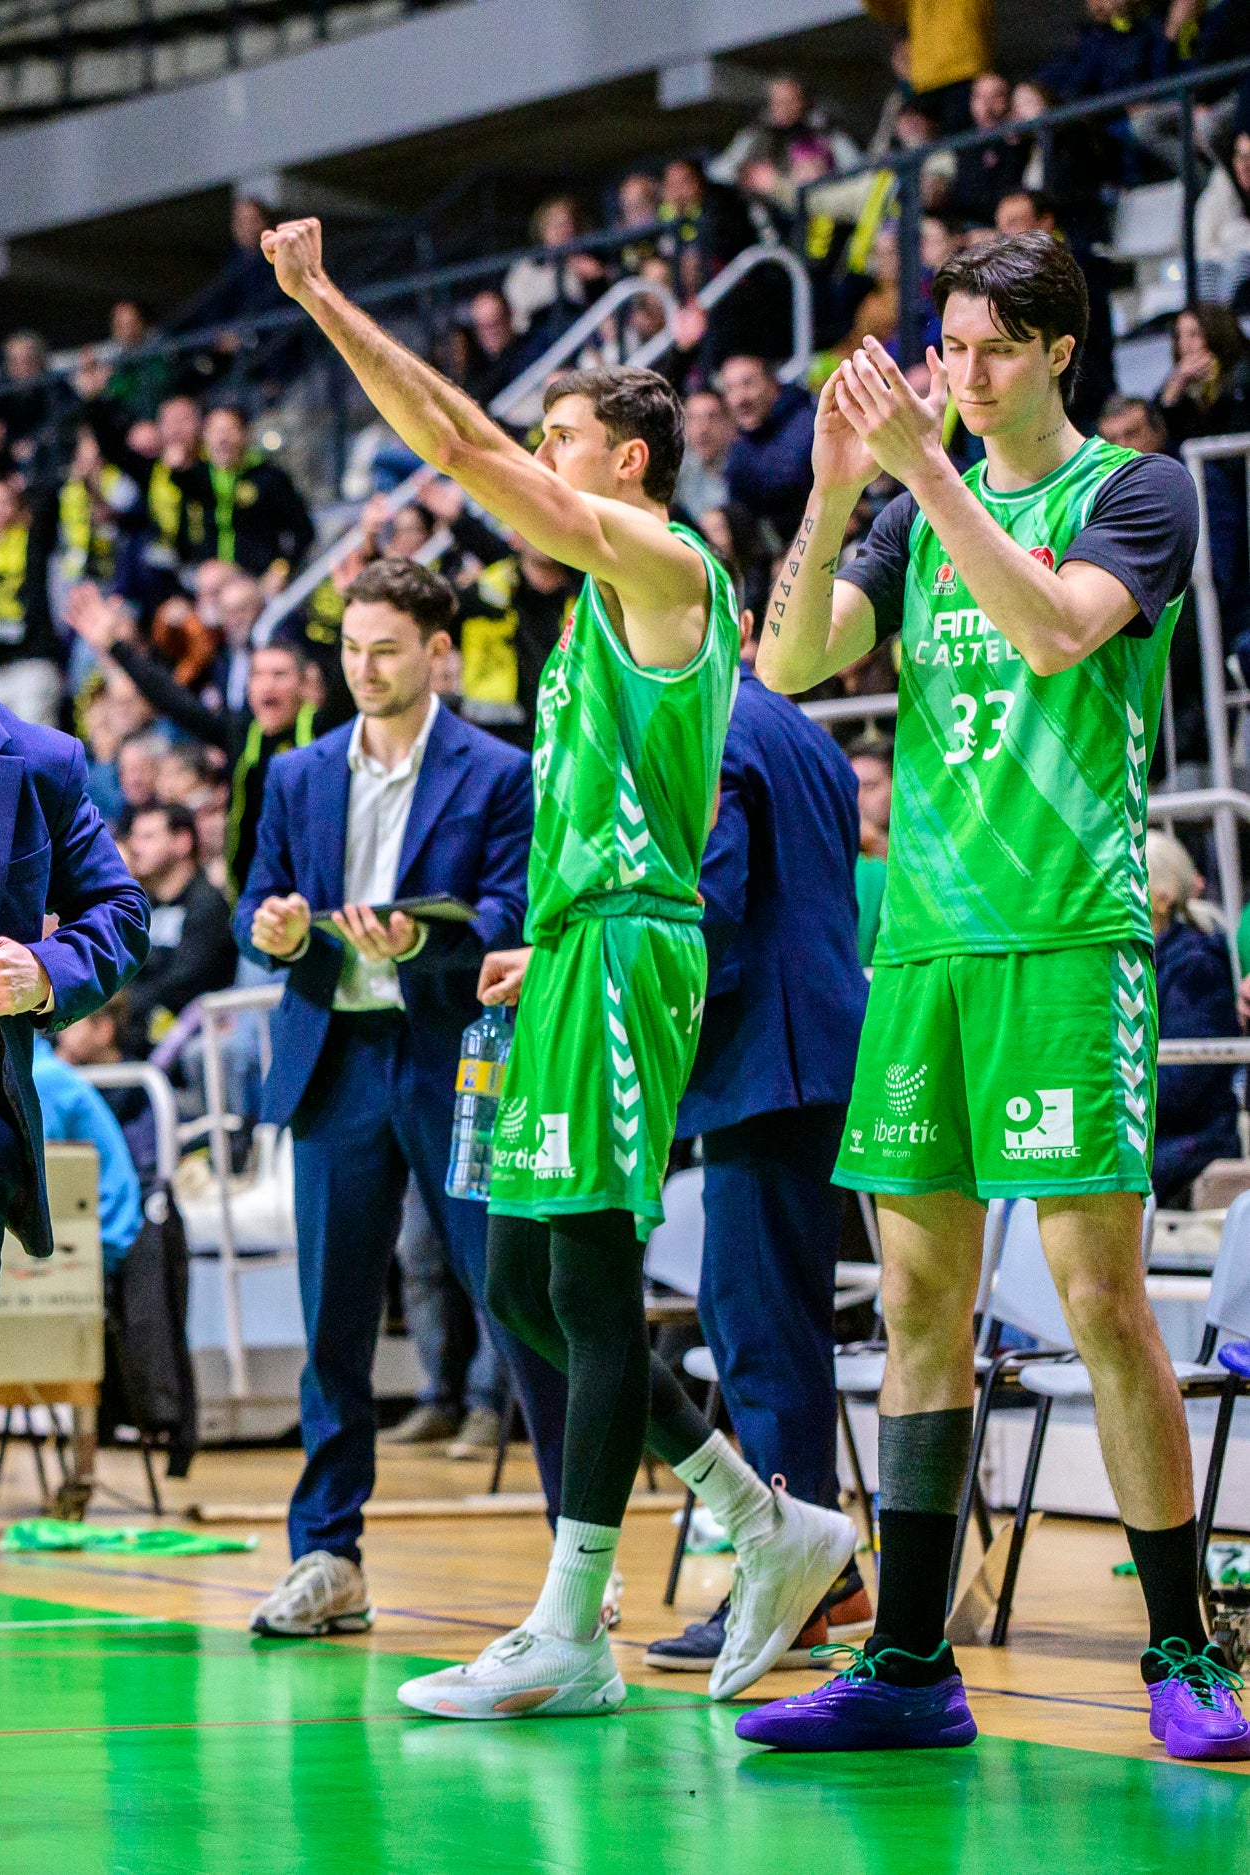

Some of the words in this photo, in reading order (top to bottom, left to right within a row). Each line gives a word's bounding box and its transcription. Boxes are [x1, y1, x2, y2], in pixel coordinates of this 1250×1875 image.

[943, 689, 1016, 765] 33
[873, 1117, 939, 1144] ibertic
[1000, 1146, 1082, 1160] VALFORTEC
